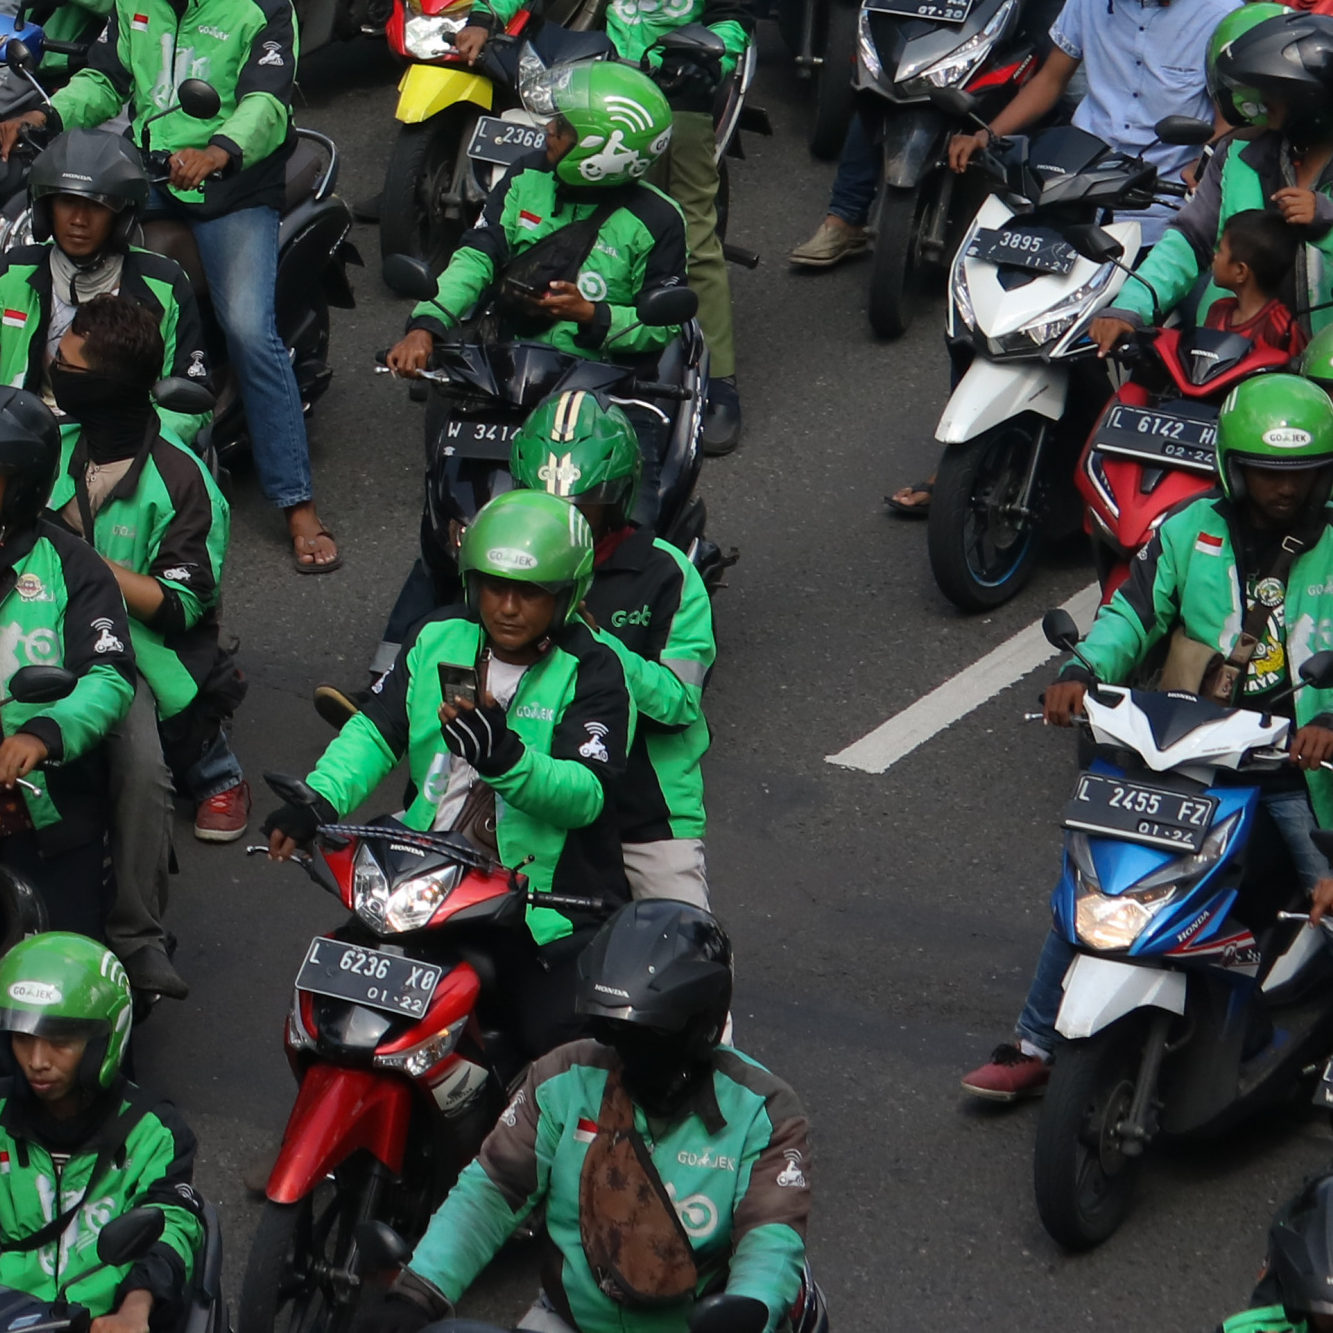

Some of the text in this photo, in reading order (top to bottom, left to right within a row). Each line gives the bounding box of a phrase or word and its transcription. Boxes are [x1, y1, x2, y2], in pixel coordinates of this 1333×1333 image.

[478, 120, 545, 150] L 2368
[62, 172, 93, 182] HONDA
[1036, 164, 1066, 174] HONDA
[999, 231, 1043, 253] 3895
[1191, 349, 1220, 360] HONDA
[447, 422, 462, 438] W
[1112, 410, 1185, 440] L 6142
[1269, 433, 1282, 443] GO
[1167, 692, 1198, 703] HONDA
[1078, 782, 1207, 826] L 2455 FZ
[389, 843, 426, 857] HONDA
[1177, 910, 1210, 943] HONDA
[309, 944, 391, 980] L 6236
[13, 986, 53, 1000] GO JEK
[594, 983, 630, 999] HONDA
[677, 1151, 736, 1172] GO JEK
